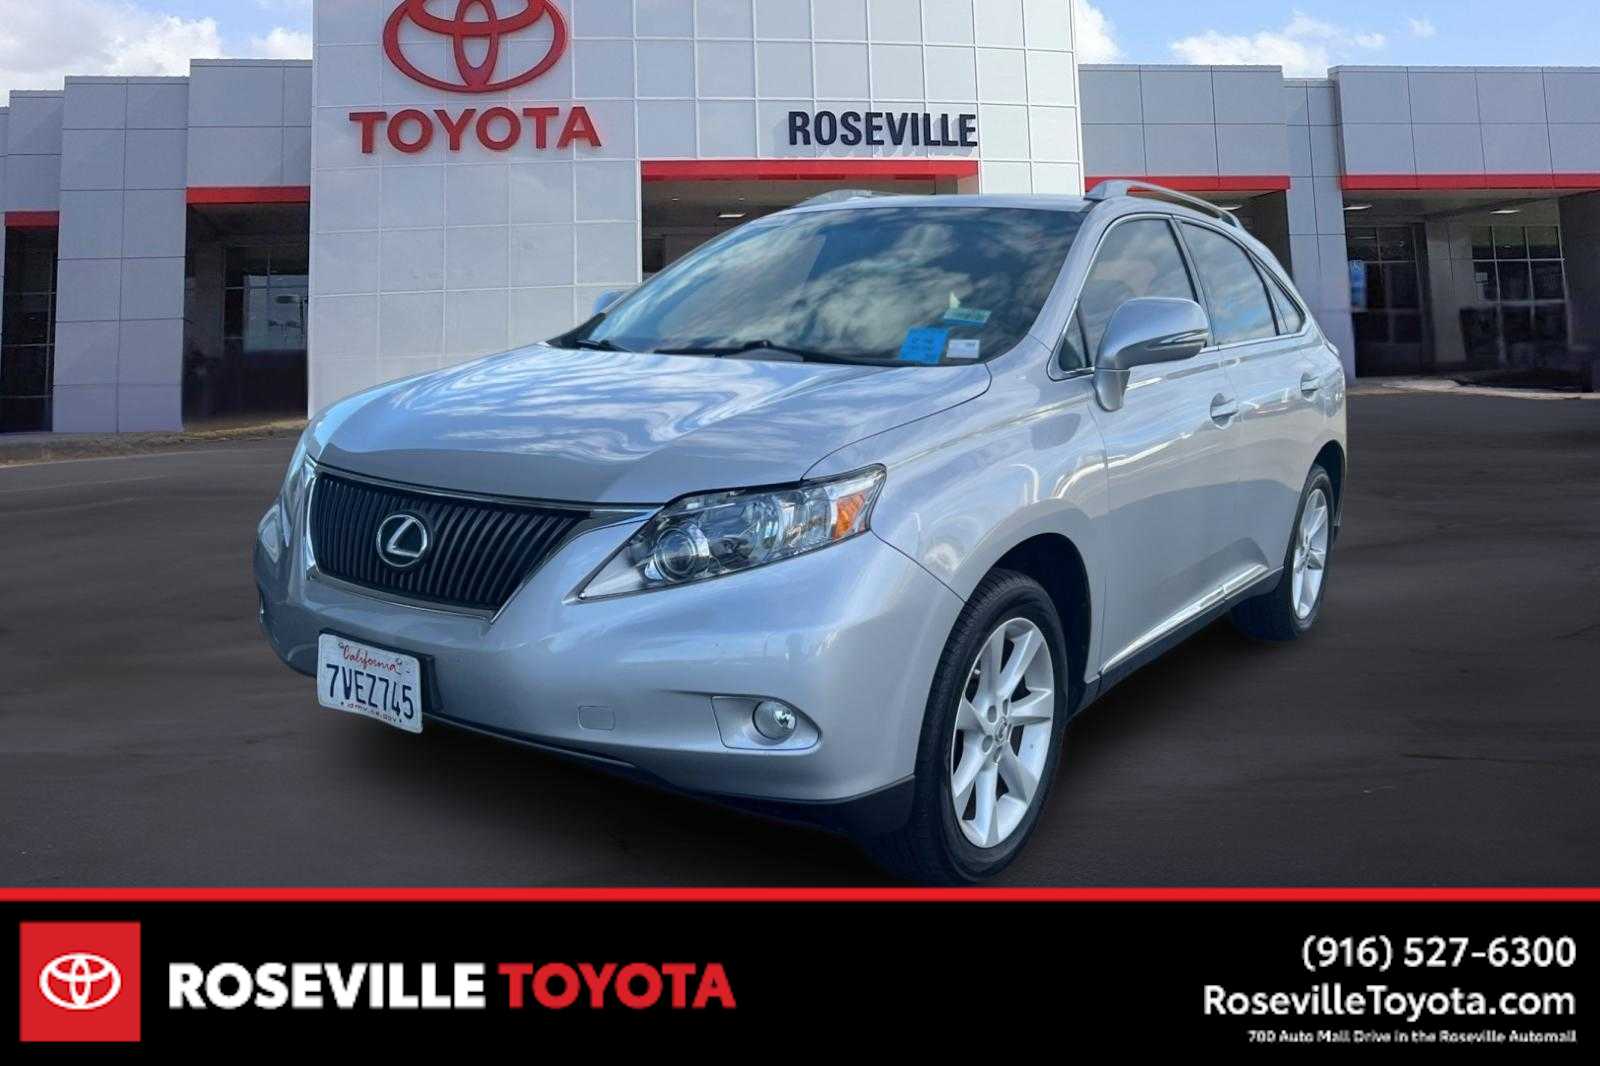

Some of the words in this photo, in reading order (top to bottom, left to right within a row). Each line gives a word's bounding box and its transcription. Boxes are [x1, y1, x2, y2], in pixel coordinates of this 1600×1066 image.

[350, 106, 602, 154] TOYOTA
[788, 111, 977, 147] ROSEVILLE
[343, 645, 398, 672] California
[326, 664, 414, 719] 7VEZ745
